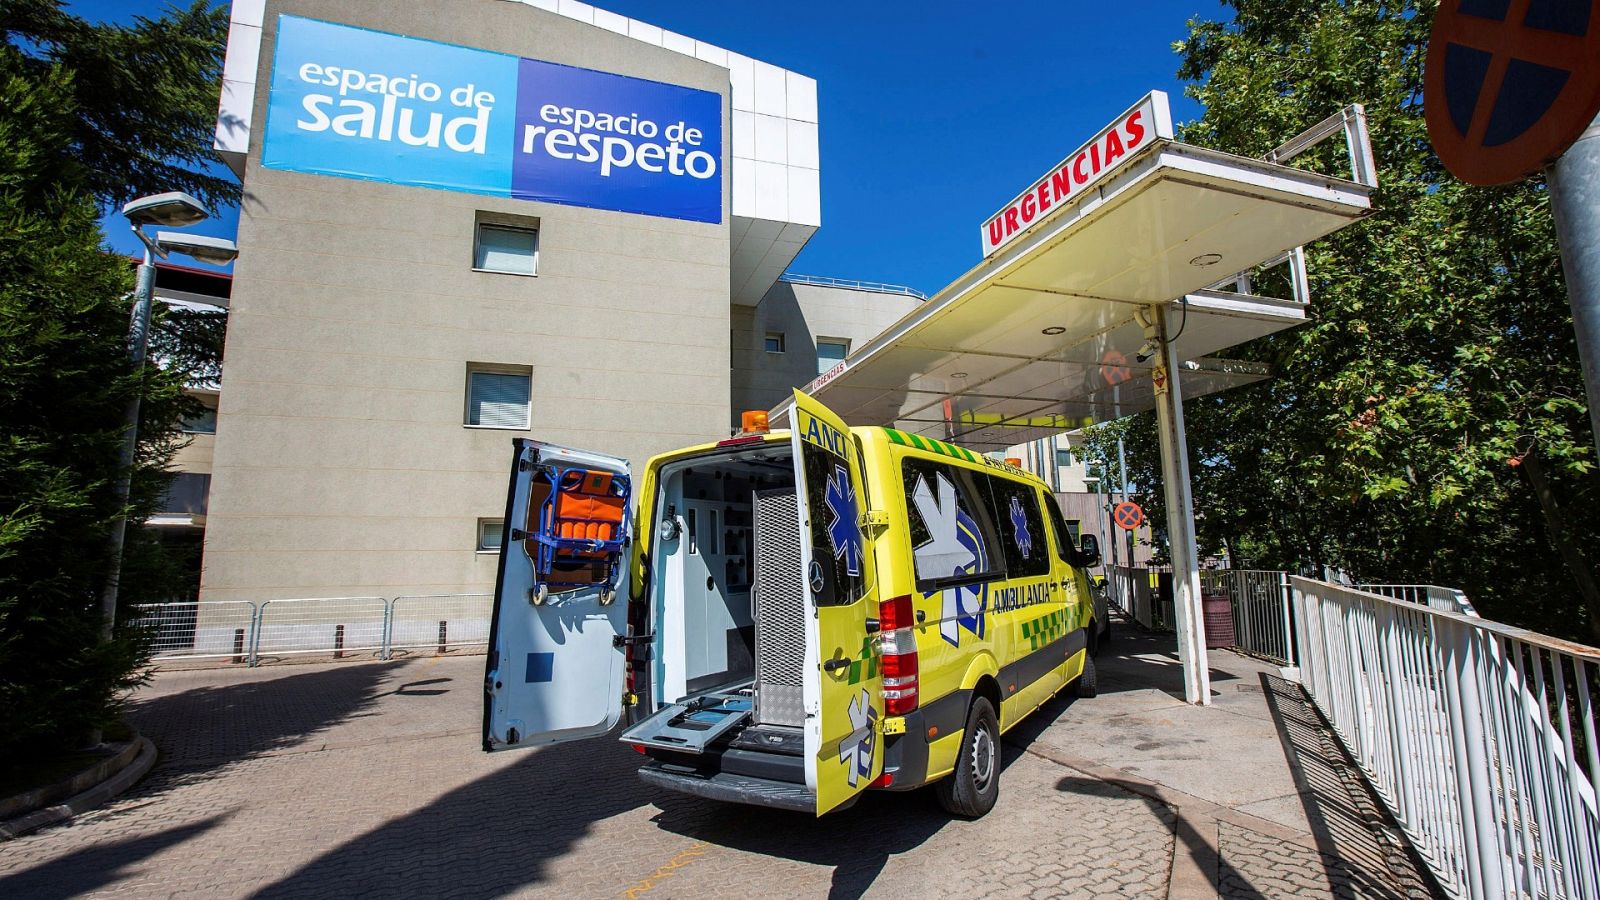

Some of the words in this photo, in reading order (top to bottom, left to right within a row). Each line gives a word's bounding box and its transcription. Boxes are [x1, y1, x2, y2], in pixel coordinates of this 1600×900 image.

[299, 62, 442, 103] espacio
[450, 83, 495, 111] de
[297, 93, 490, 155] salud
[540, 103, 658, 140] espacio
[665, 121, 703, 147] de
[522, 123, 716, 179] respeto
[989, 110, 1145, 246] URGENCIAS
[813, 363, 844, 389] URGENCIAS
[992, 582, 1051, 615] AMBULANCIA
